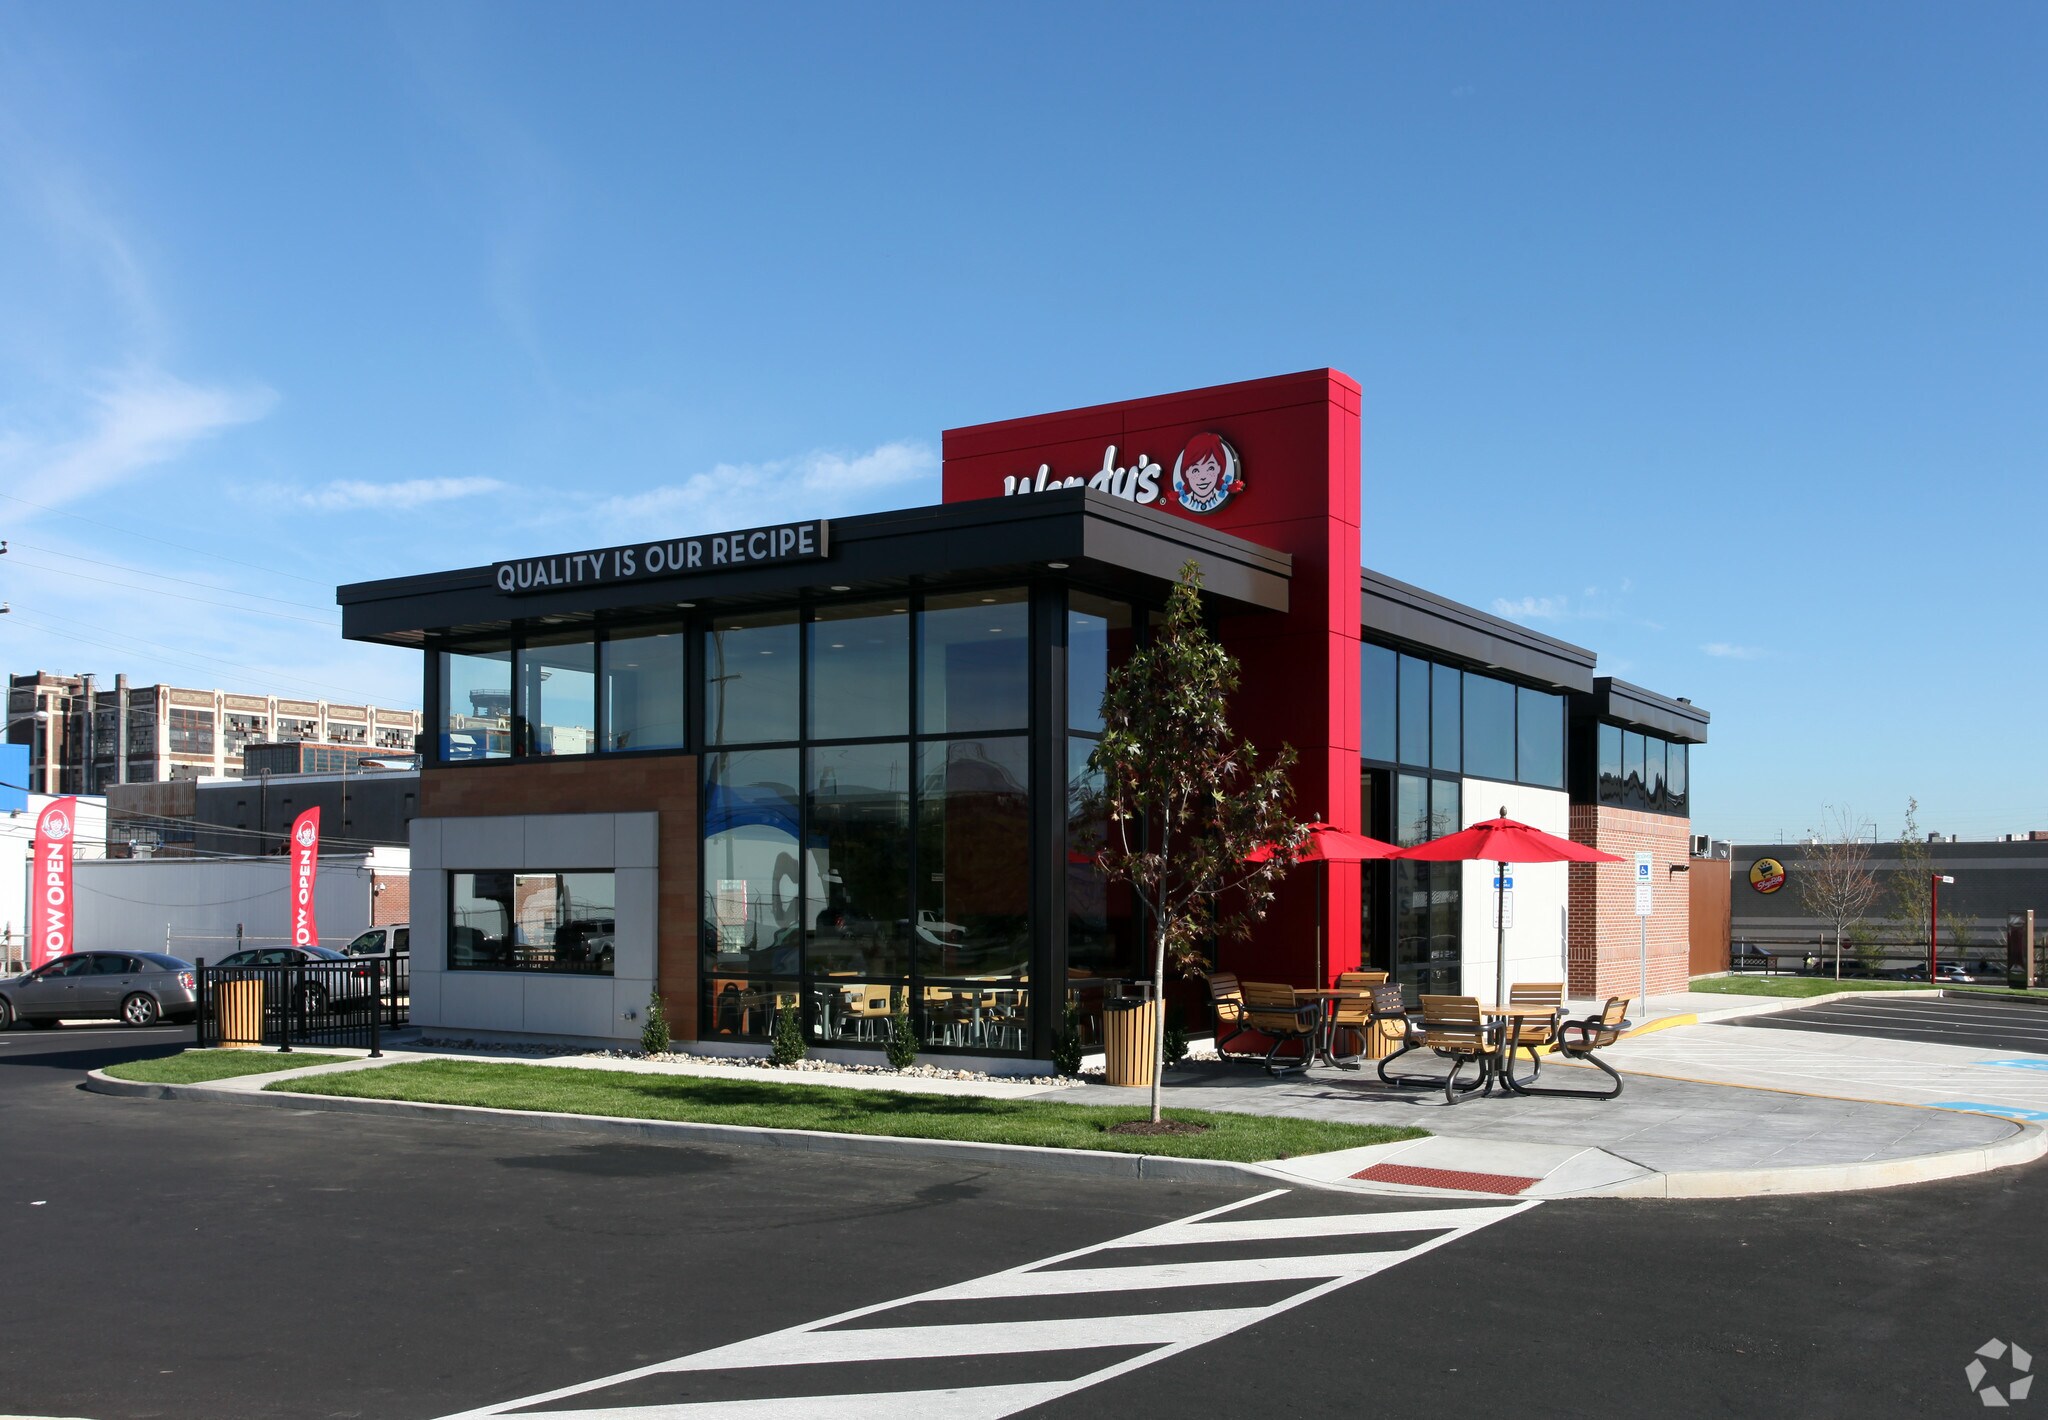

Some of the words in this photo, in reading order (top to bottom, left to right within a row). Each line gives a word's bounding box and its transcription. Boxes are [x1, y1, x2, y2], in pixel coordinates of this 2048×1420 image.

[497, 553, 605, 592] QUALITY
[615, 549, 636, 577] IS
[645, 541, 702, 573] OUR
[712, 525, 814, 565] RECIPE
[46, 842, 65, 906] OPEN
[298, 850, 311, 905] OPEN
[296, 907, 311, 947] OW
